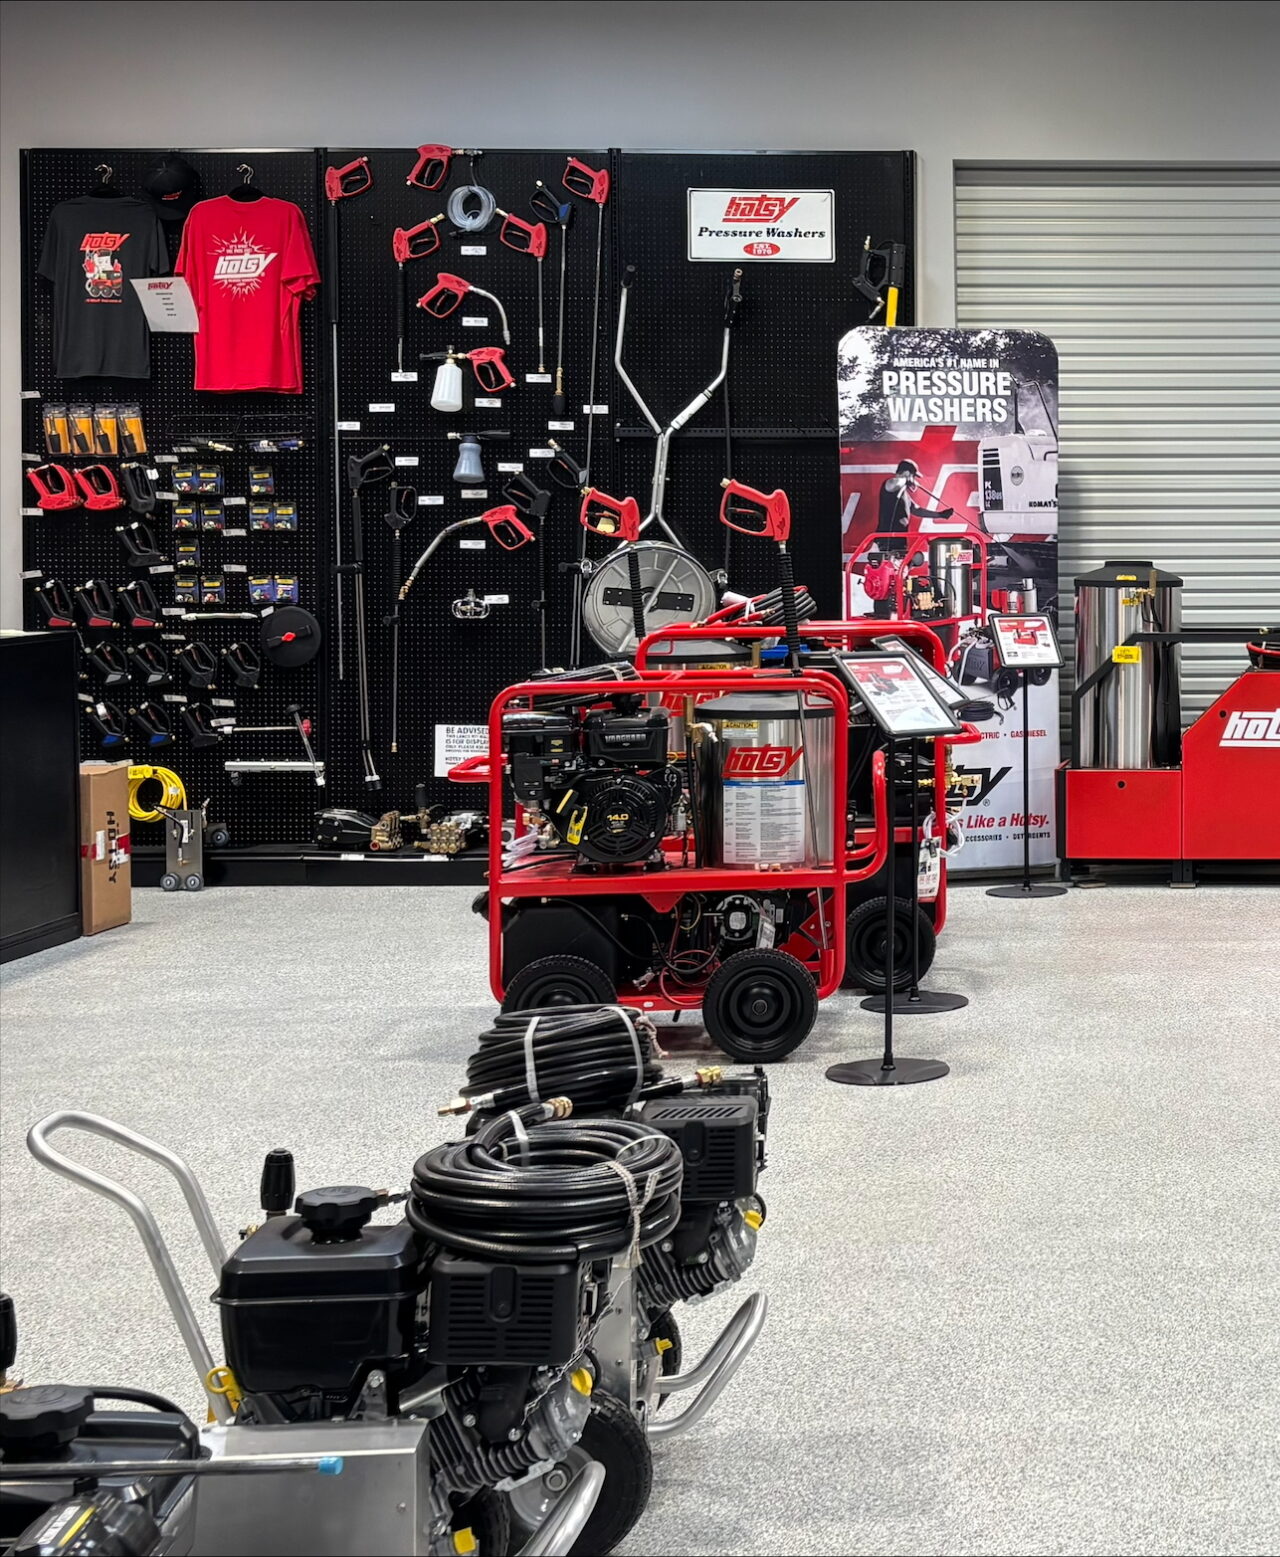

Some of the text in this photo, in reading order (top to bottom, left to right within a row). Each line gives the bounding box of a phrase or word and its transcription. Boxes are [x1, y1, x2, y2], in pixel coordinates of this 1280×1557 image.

[722, 195, 800, 222] hotsy
[698, 227, 826, 239] Pressure Washers
[213, 252, 278, 280] hotsy
[893, 357, 944, 368] AMERICA'S
[960, 358, 987, 368] NAME
[990, 358, 1000, 369] IN
[882, 370, 1012, 396] PRESSURE
[887, 397, 1008, 422] WASHERS
[1029, 500, 1057, 508] KOMATS
[722, 744, 804, 778] hotsy
[966, 815, 996, 829] Like
[998, 816, 1007, 827] a
[966, 834, 1002, 842] CCESSORIES
